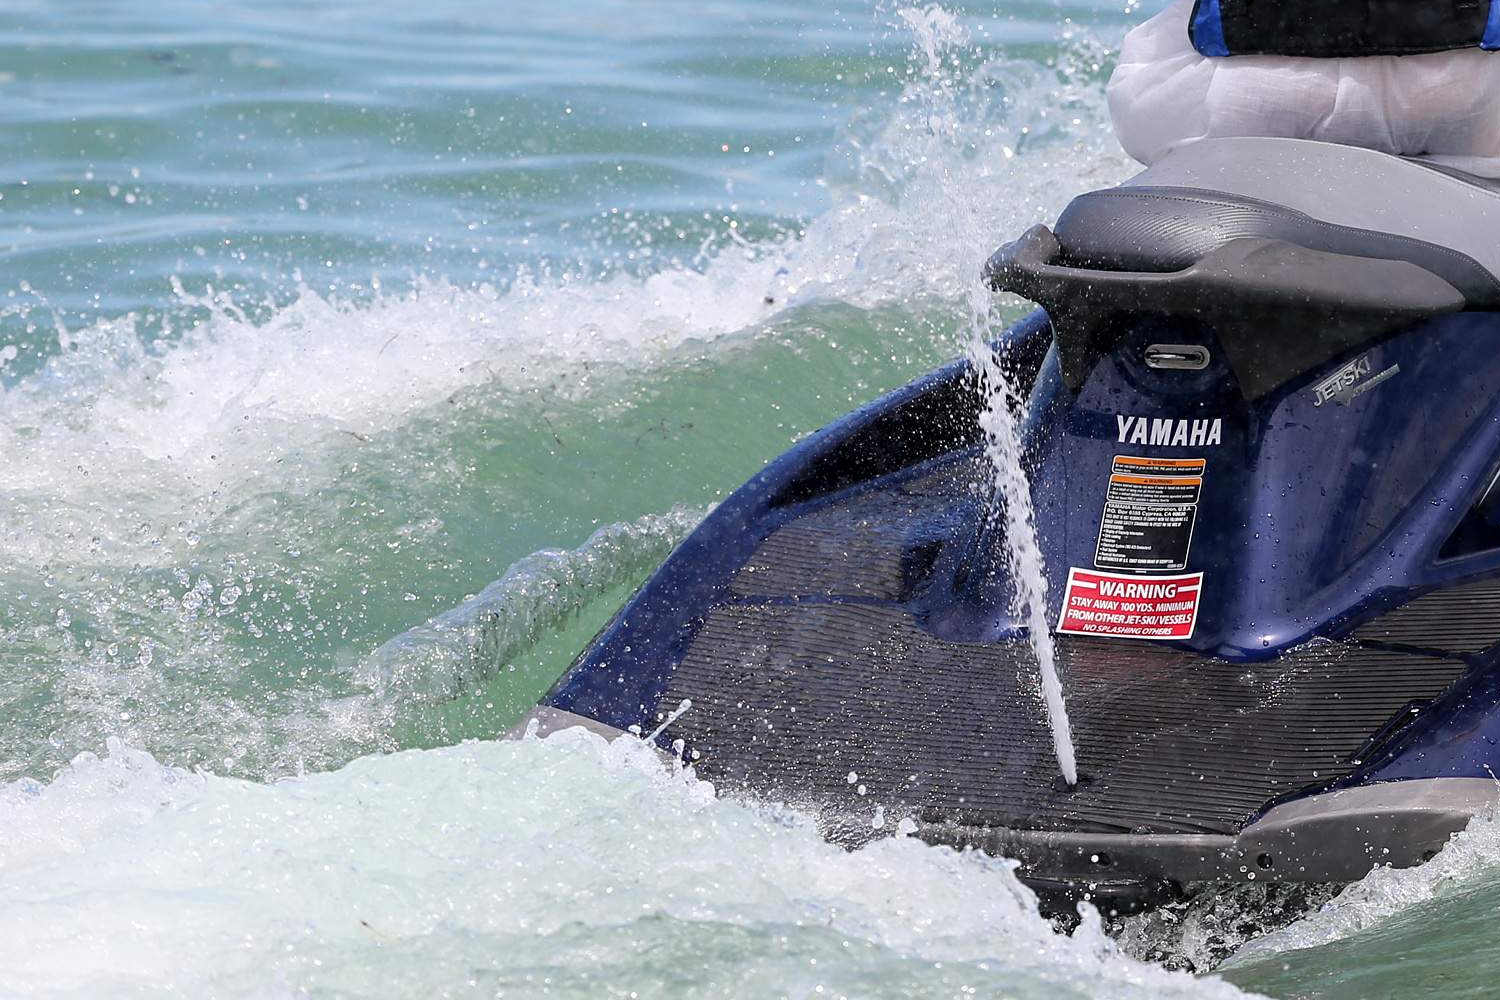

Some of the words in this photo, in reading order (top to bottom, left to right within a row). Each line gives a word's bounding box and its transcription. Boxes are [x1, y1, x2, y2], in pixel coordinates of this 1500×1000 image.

[1116, 415, 1222, 446] YAMAHA
[1099, 580, 1177, 599] WARNING
[1071, 596, 1092, 608] STAY
[1092, 599, 1119, 612] AWAY
[1120, 602, 1136, 612] 100
[1136, 603, 1155, 613] YDS.
[1156, 601, 1194, 613] MINIMUM
[1067, 609, 1095, 621] FROM
[1095, 612, 1125, 624] OTHER
[1159, 613, 1192, 625] VESSELS
[1082, 623, 1097, 632] NO
[1096, 624, 1141, 635] SPLASHING
[1141, 627, 1173, 635] OTHERS
